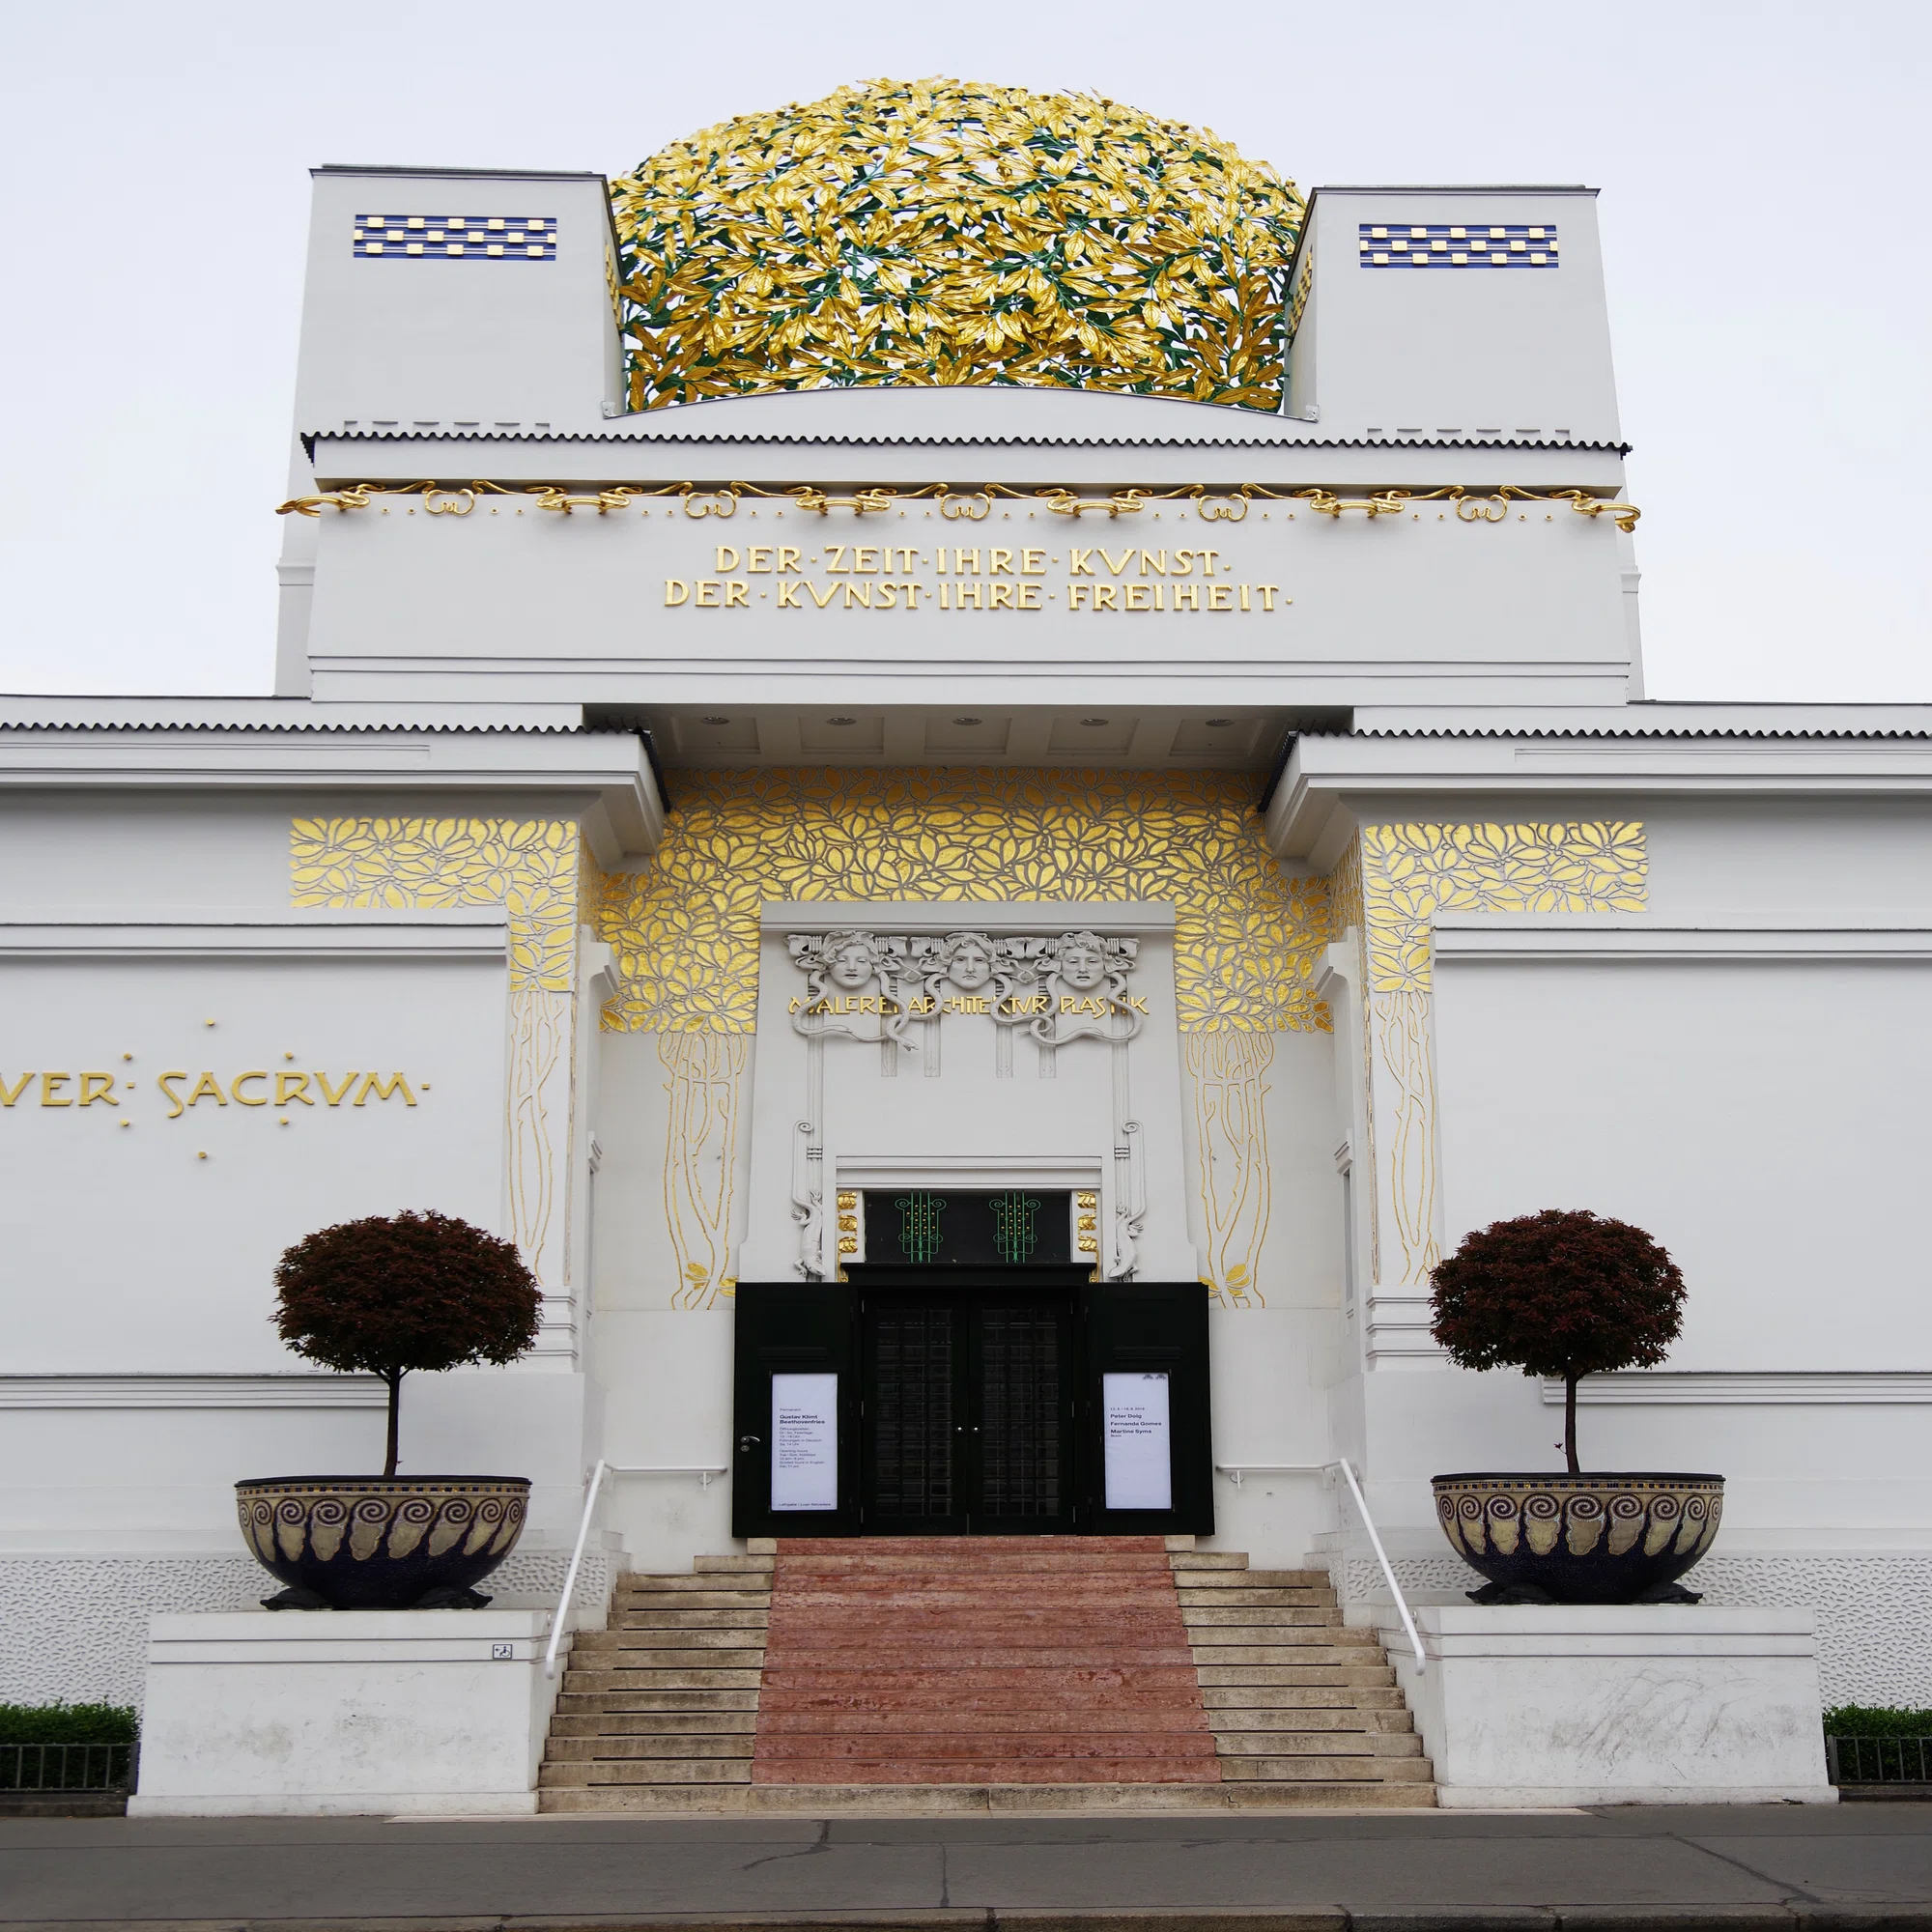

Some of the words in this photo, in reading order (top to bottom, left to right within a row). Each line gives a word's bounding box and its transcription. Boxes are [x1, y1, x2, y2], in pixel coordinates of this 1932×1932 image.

[715, 546, 803, 574] DER
[824, 546, 918, 575] ZEIT
[937, 548, 1046, 576] IHRE
[664, 580, 751, 608] DER
[939, 582, 1042, 611] IHRE
